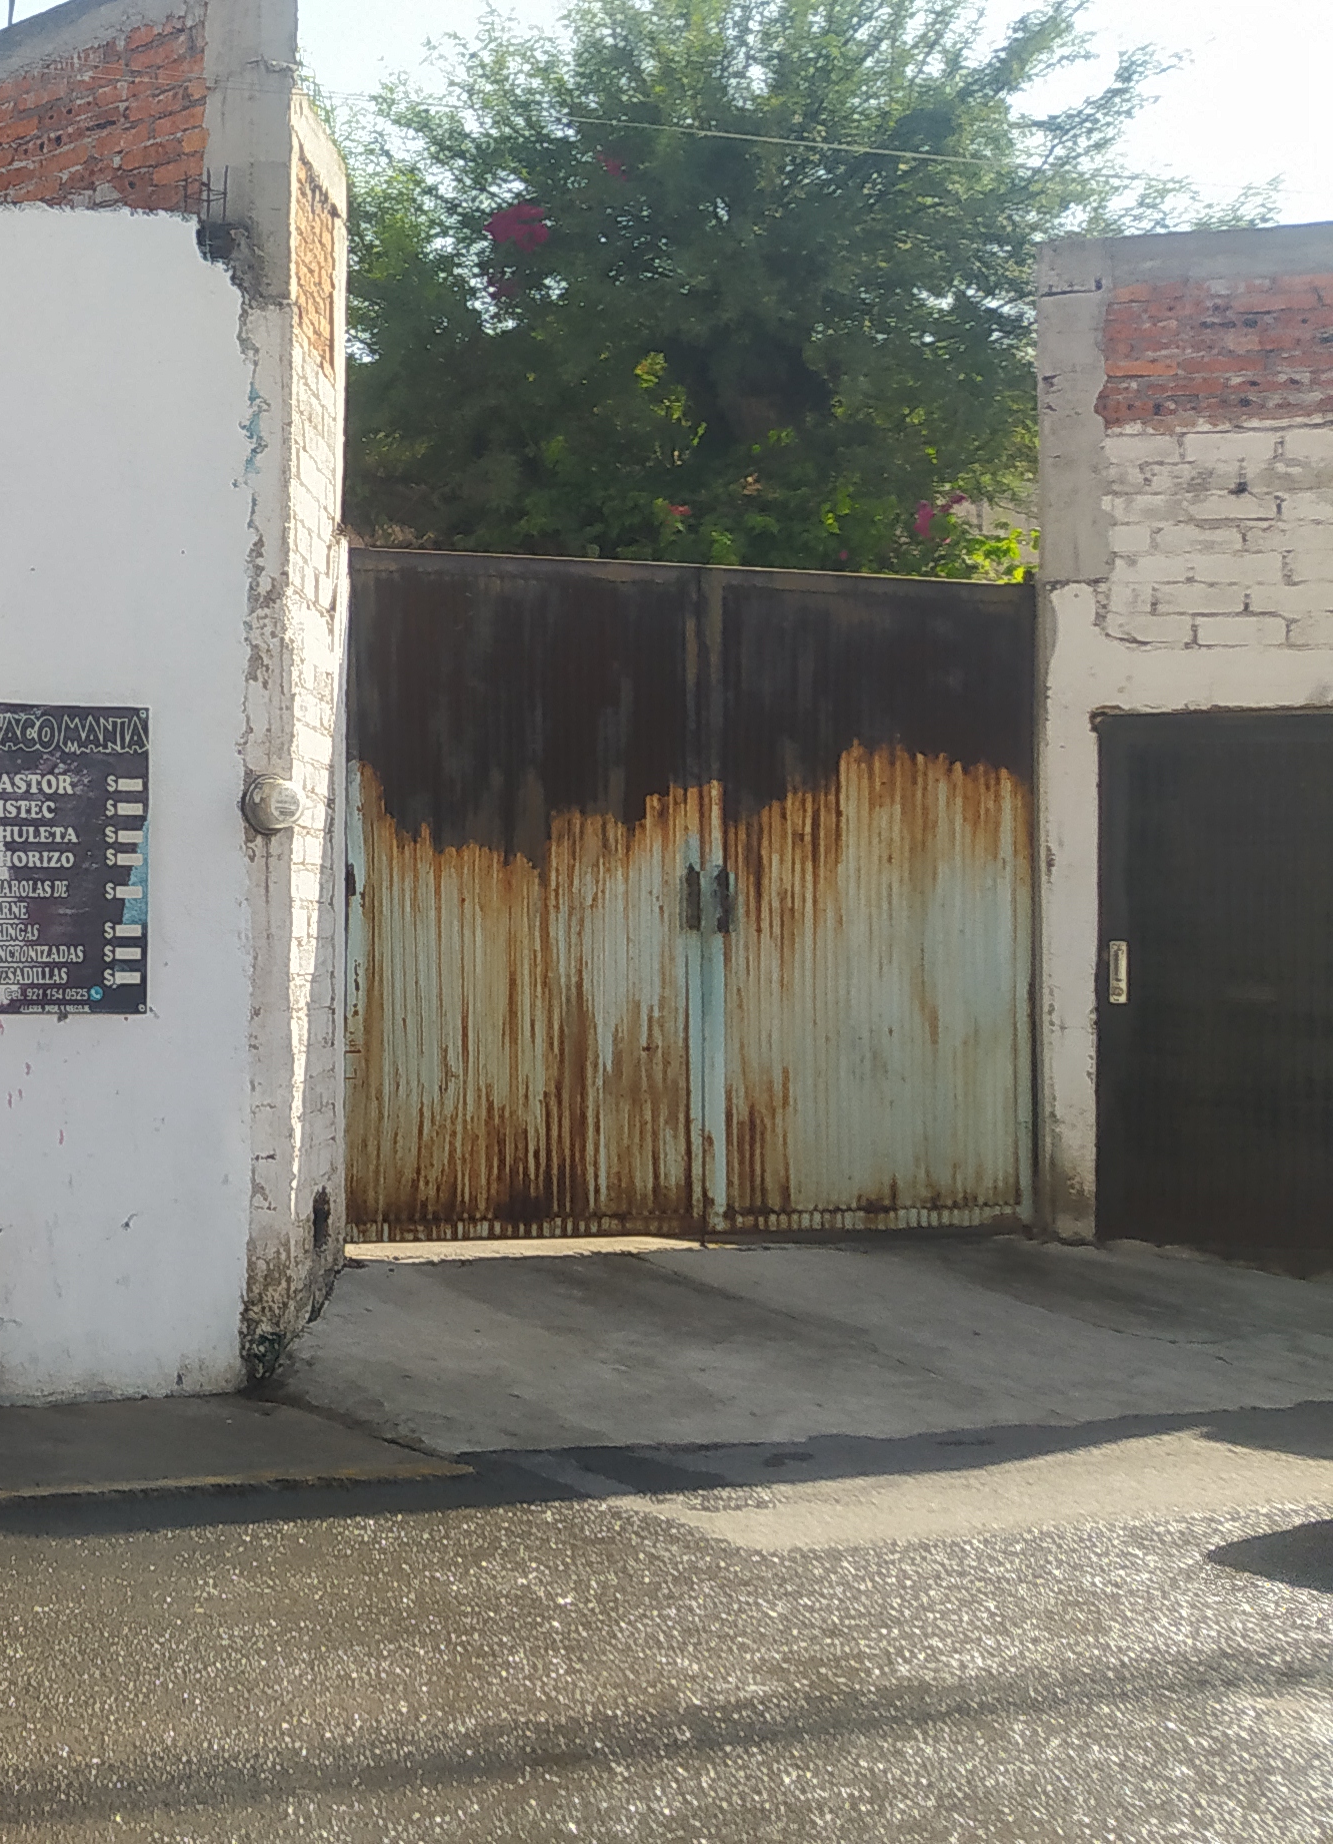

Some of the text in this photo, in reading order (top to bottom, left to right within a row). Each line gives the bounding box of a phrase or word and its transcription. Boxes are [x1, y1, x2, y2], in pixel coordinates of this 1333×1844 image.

[60, 713, 150, 754] MANIA
[105, 775, 117, 793] $
[105, 800, 115, 817] $
[104, 826, 116, 844] $
[104, 849, 116, 866] $
[53, 880, 69, 898] DE
[104, 882, 115, 900] $
[103, 921, 114, 939] $
[103, 945, 114, 963] $
[103, 969, 114, 986] $
[27, 988, 43, 1000] 921
[46, 988, 63, 1000] 154
[65, 988, 88, 1000] 0525
